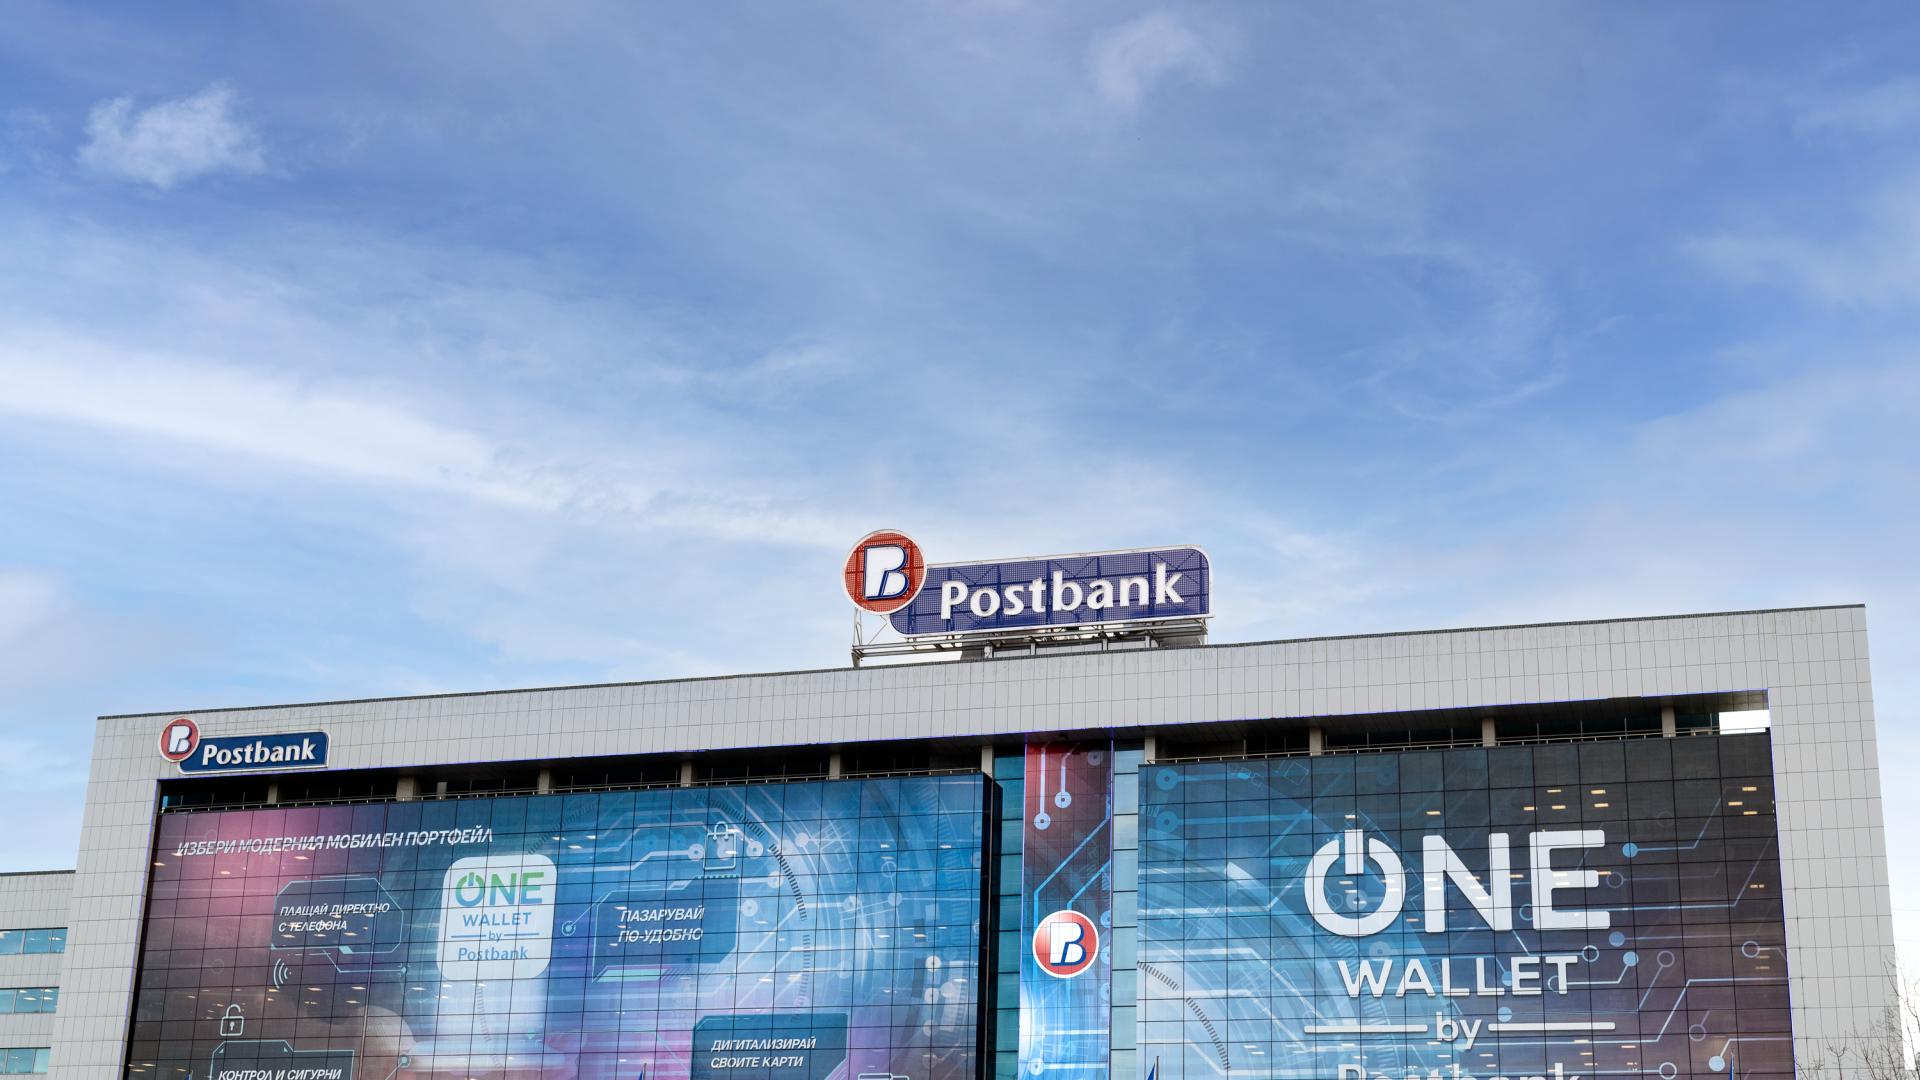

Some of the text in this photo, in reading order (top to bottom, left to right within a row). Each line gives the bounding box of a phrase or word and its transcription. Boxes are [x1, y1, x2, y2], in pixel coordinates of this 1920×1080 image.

[940, 562, 1185, 620] Postbank
[202, 738, 316, 766] Postbank
[177, 825, 493, 856] ИЗБЕРИ МОДЕРНИЯ МОБИЛЕН ПОРТФЕЙЛ
[455, 872, 544, 907] ONE
[1304, 829, 1611, 937] ONE
[280, 903, 390, 917] ПЛАЩАЙ ДИРЕКТНО
[620, 904, 705, 922] ПАЗАРУВАЙ
[278, 920, 347, 932] С ТЕЛЕФОНА
[463, 912, 532, 927] WALLET
[488, 930, 502, 943] by
[618, 928, 704, 944] ПО-УДОБНО
[458, 946, 529, 961] Postbank
[1337, 955, 1579, 998] WALLET
[1435, 1011, 1482, 1050] by
[711, 1036, 817, 1053] ДИГИТАЛИЗИРАЙ
[711, 1056, 804, 1068] СВОИТЕ КАРТИ
[218, 1069, 342, 1080] КОНТРОЛ И СИГУРНИ
